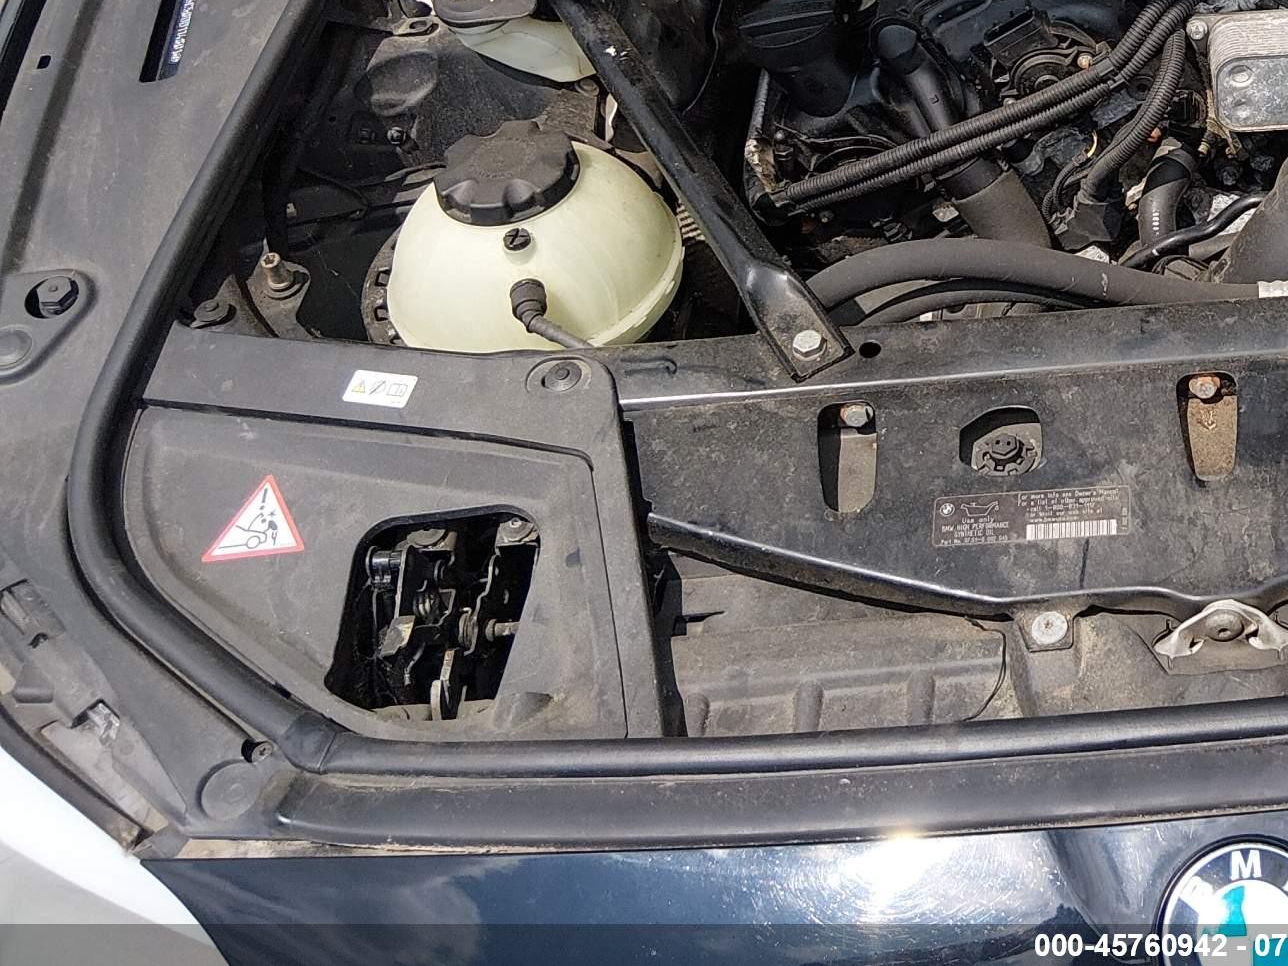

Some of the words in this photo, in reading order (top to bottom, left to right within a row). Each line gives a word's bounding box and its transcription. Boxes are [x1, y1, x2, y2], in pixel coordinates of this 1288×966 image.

[978, 515, 995, 524] only
[972, 521, 1009, 530] PERFORMANCE
[985, 528, 995, 536] OIL
